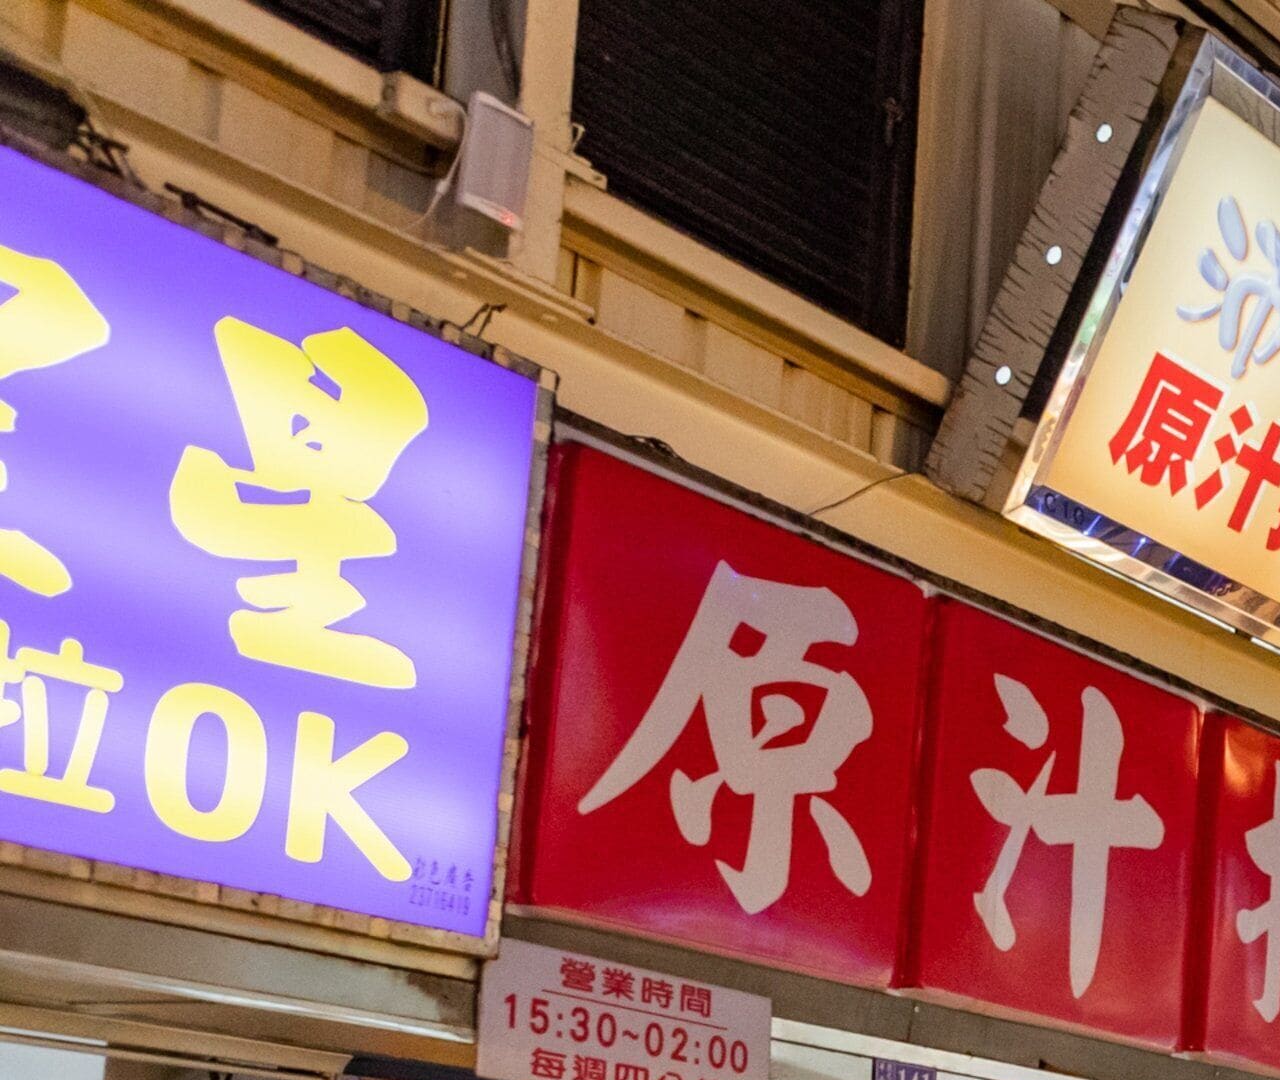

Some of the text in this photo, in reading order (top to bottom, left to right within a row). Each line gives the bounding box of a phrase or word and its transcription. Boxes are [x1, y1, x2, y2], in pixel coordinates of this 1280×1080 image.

[558, 956, 713, 1019] 營業時間
[503, 993, 749, 1074] 15:30~02:00
